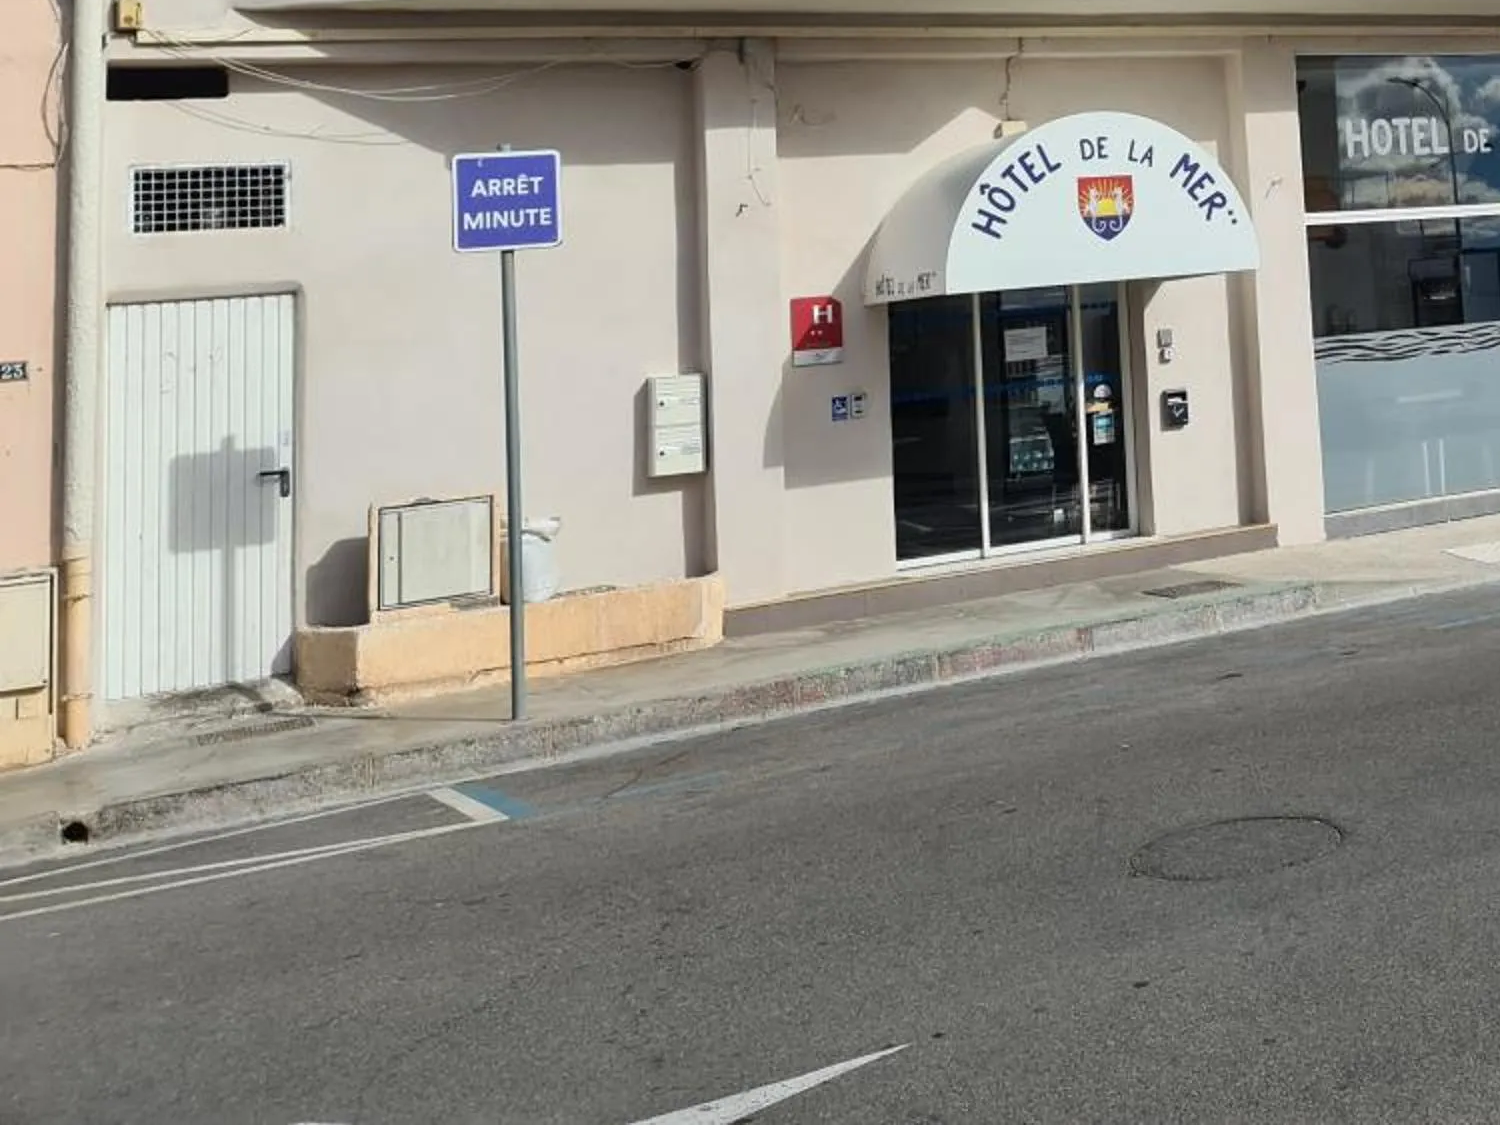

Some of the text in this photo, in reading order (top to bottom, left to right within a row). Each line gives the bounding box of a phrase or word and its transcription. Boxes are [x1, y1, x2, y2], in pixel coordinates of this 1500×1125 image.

[1345, 116, 1450, 158] HOTEL
[1463, 128, 1492, 153] DE
[471, 173, 544, 197] ARRÊT
[971, 136, 1227, 239] HÔTEL DE LA MER
[463, 207, 553, 231] MINUTE
[813, 304, 833, 324] H
